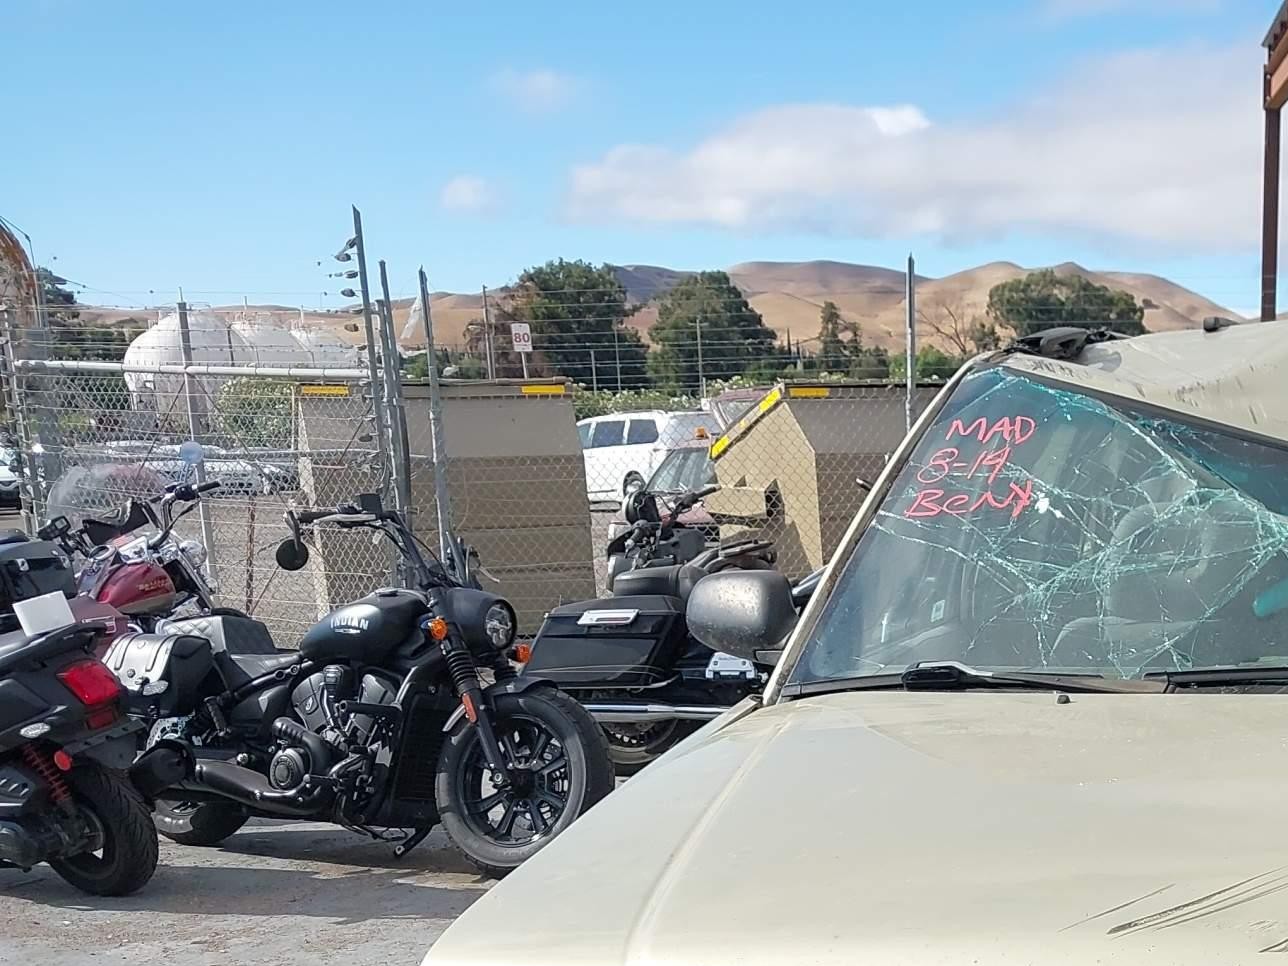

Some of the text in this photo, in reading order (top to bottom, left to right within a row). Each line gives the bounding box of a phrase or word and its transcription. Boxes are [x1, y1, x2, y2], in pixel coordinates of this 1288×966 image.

[514, 333, 530, 343] 80
[945, 415, 1037, 445] MAD
[917, 446, 1013, 485] 8-19
[331, 616, 370, 630] INDIAN
